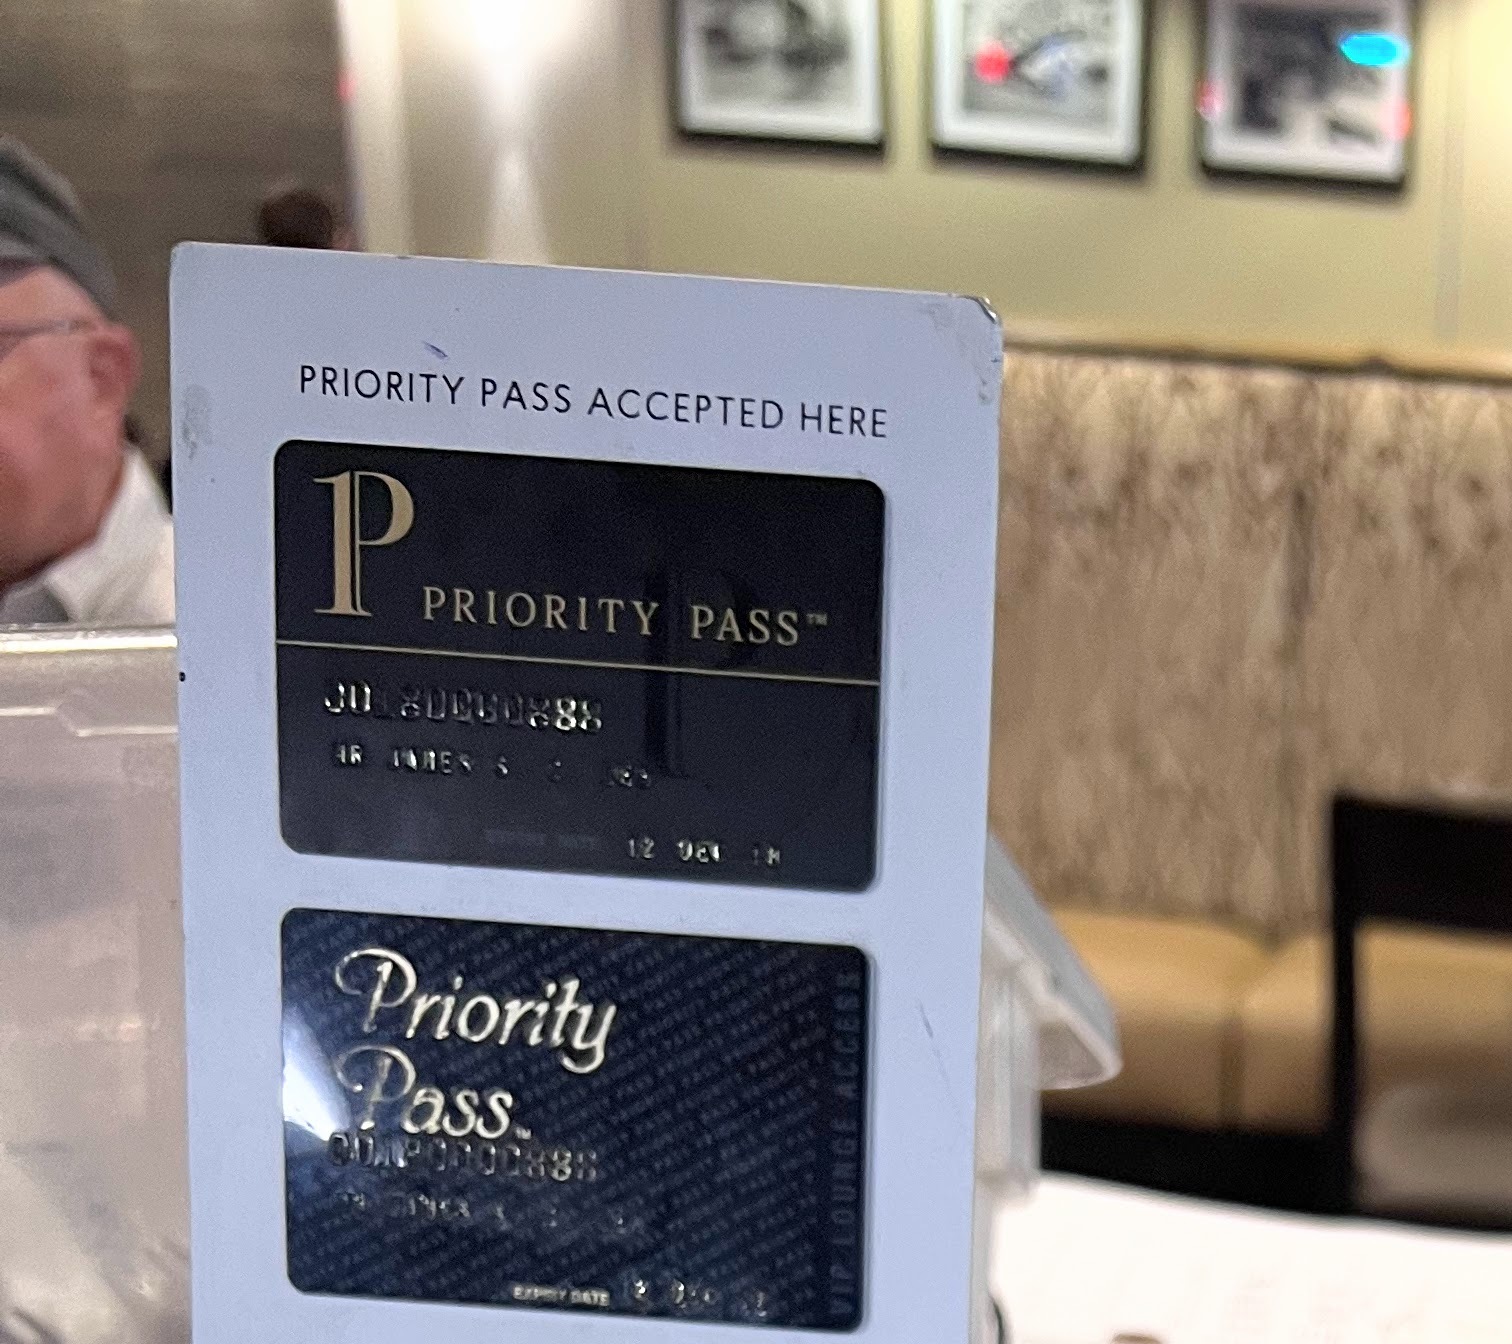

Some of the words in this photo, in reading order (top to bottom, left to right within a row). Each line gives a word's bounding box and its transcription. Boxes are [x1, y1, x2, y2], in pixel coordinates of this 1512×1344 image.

[300, 364, 465, 405] PRIORITY
[481, 377, 572, 414] PASS
[586, 387, 784, 429] ACCEPTED
[800, 402, 887, 439] HERE
[422, 585, 660, 636] PRIORITY
[334, 946, 617, 1075] Priority
